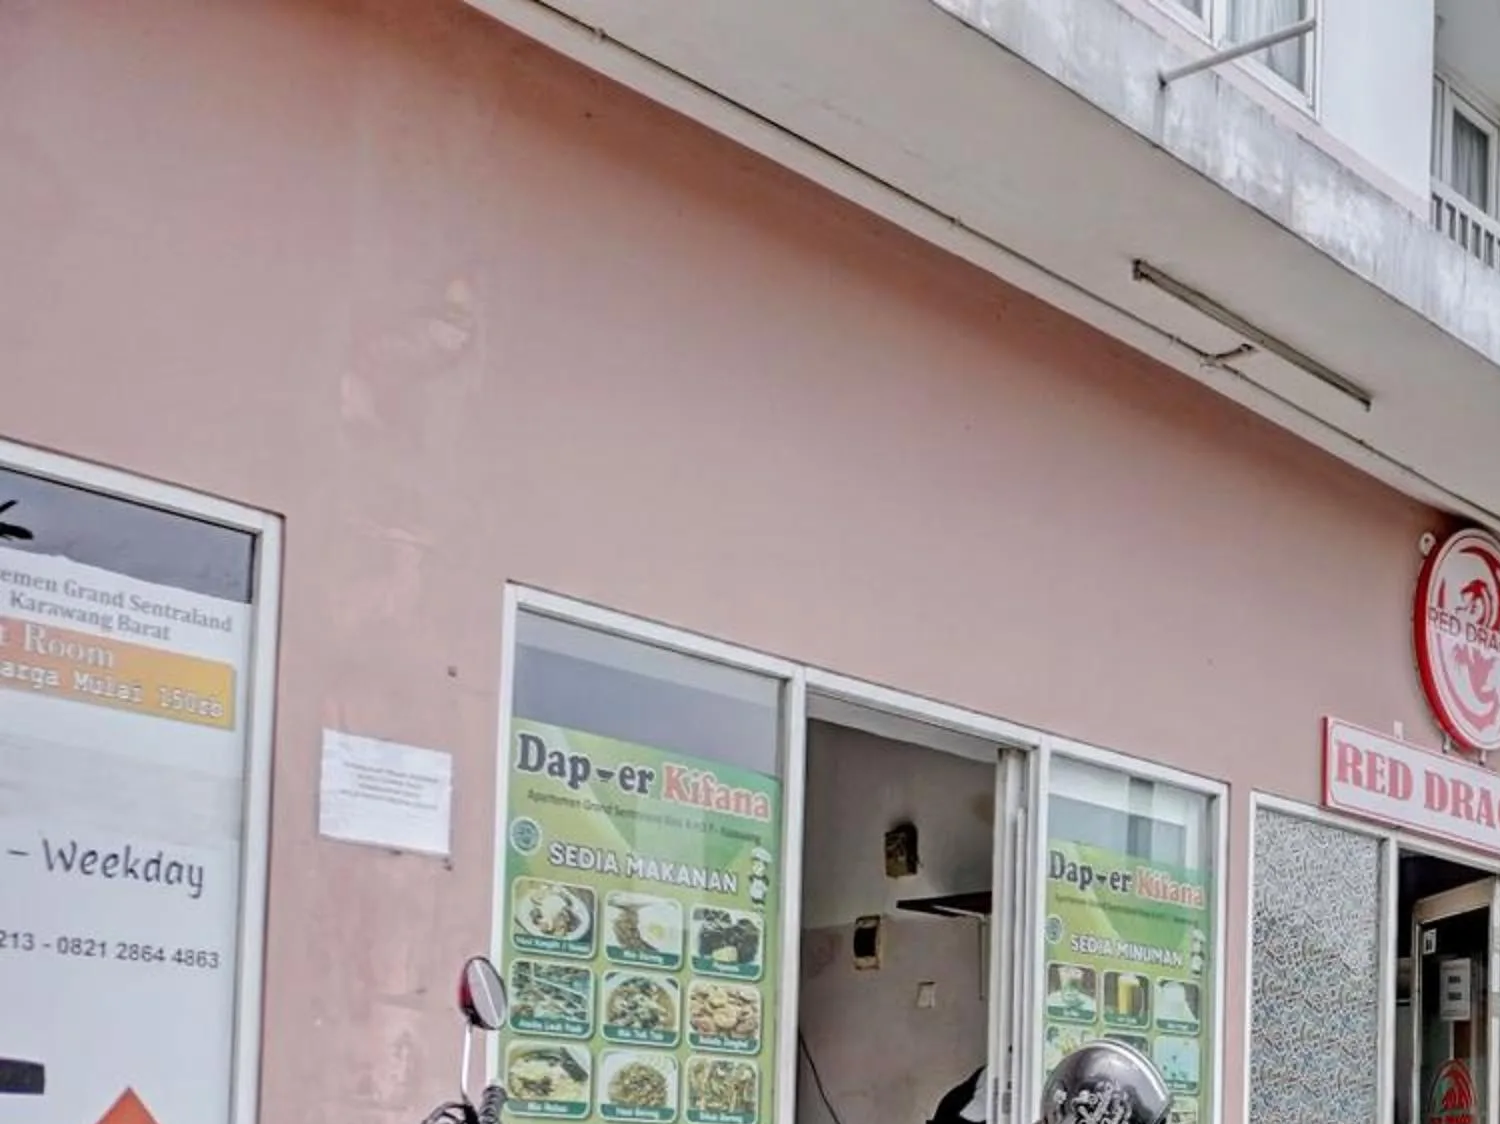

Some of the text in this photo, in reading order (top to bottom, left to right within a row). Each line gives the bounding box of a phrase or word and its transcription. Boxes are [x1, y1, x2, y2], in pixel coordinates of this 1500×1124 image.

[10, 590, 171, 641] Karawang Barat
[63, 579, 124, 609] Grand
[129, 594, 233, 632] Sentraland
[1429, 607, 1462, 636] RED
[24, 623, 114, 667] Room
[73, 670, 144, 702] Mulai
[663, 764, 770, 820] Kifana
[1334, 740, 1413, 800] RED
[42, 838, 204, 899] Weekday
[548, 842, 738, 894] SEDIA MAKANAN
[56, 936, 108, 958] 0821
[116, 941, 166, 963] 2864
[171, 949, 220, 969] 4863
[1071, 934, 1113, 955] SEDIA
